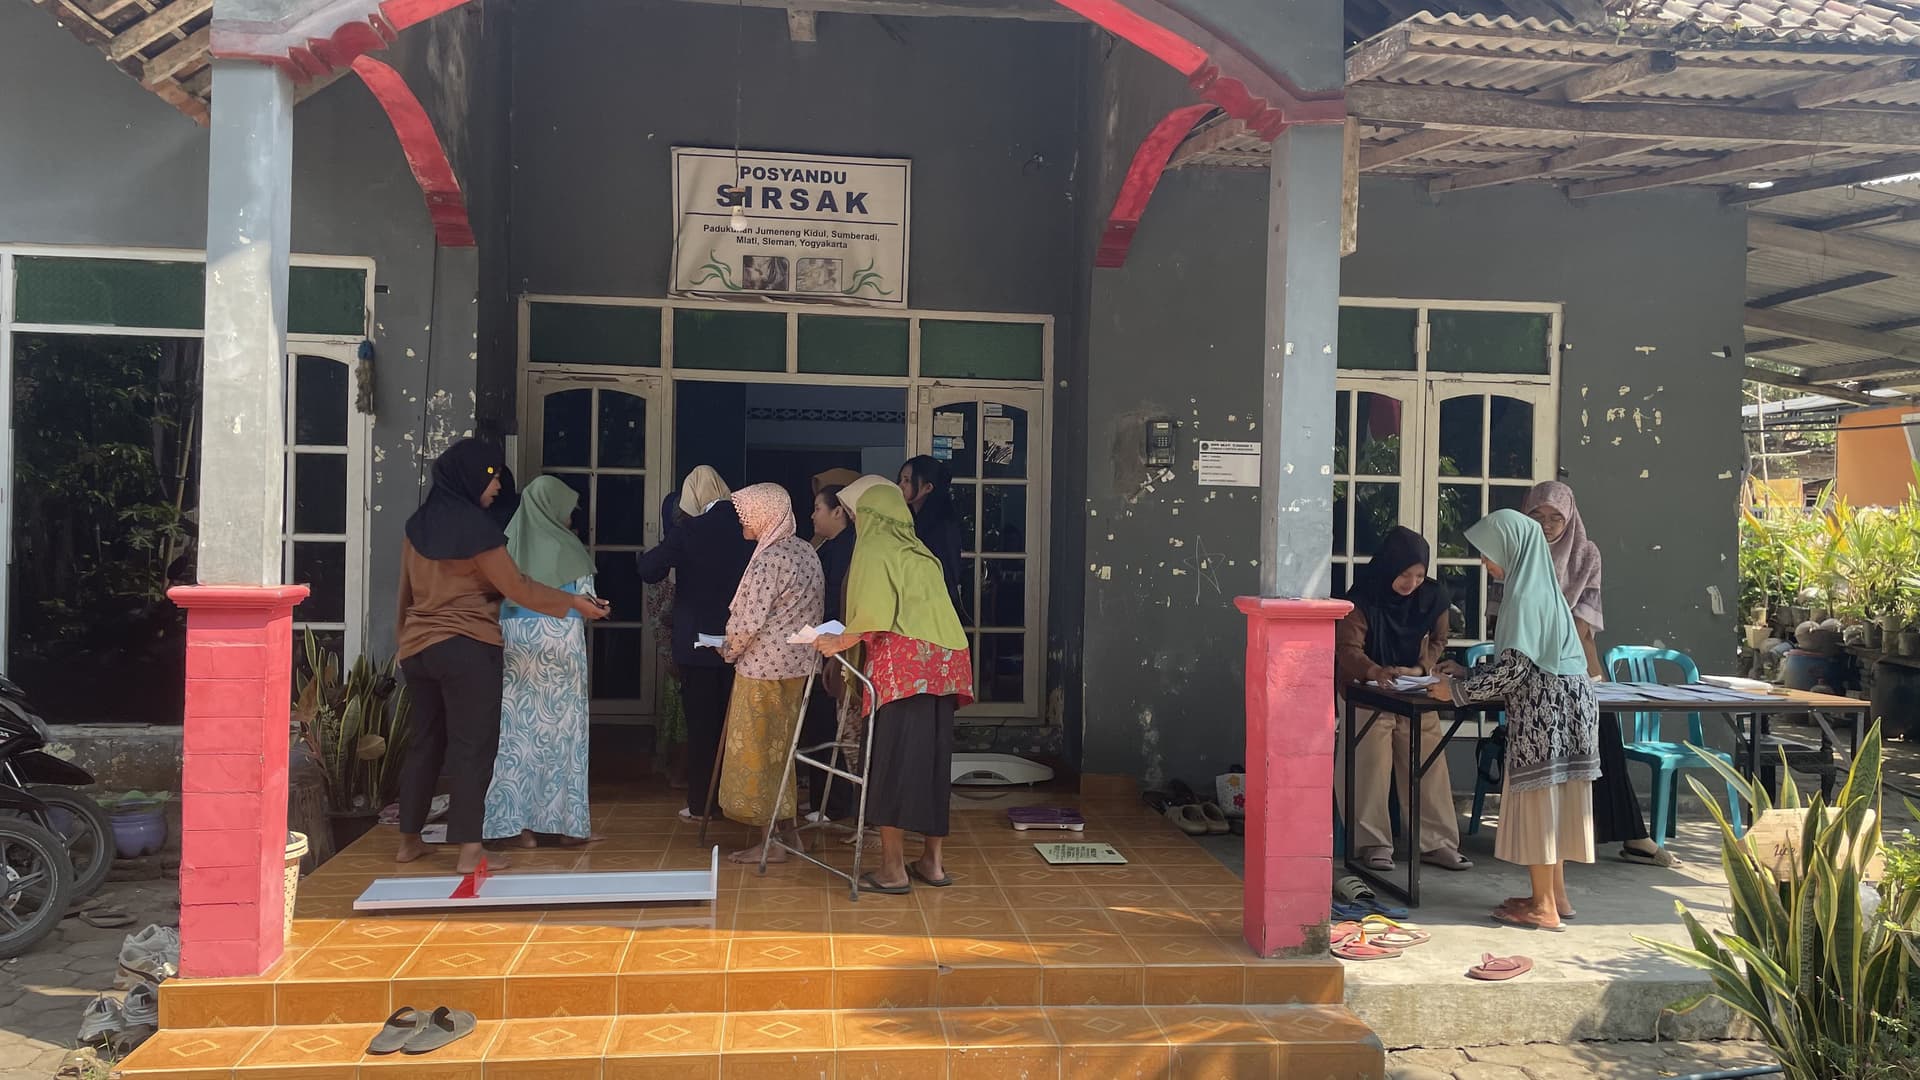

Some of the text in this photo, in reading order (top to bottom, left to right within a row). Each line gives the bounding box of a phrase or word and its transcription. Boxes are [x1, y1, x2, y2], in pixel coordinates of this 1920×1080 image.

[739, 166, 847, 185] POSYANDU
[716, 184, 869, 215] SIRSAK
[703, 224, 880, 242] Padukuan Jumeneng Kidul, Sumberadi,
[736, 236, 849, 250] Mlati, Sleman, Yogyakarta
